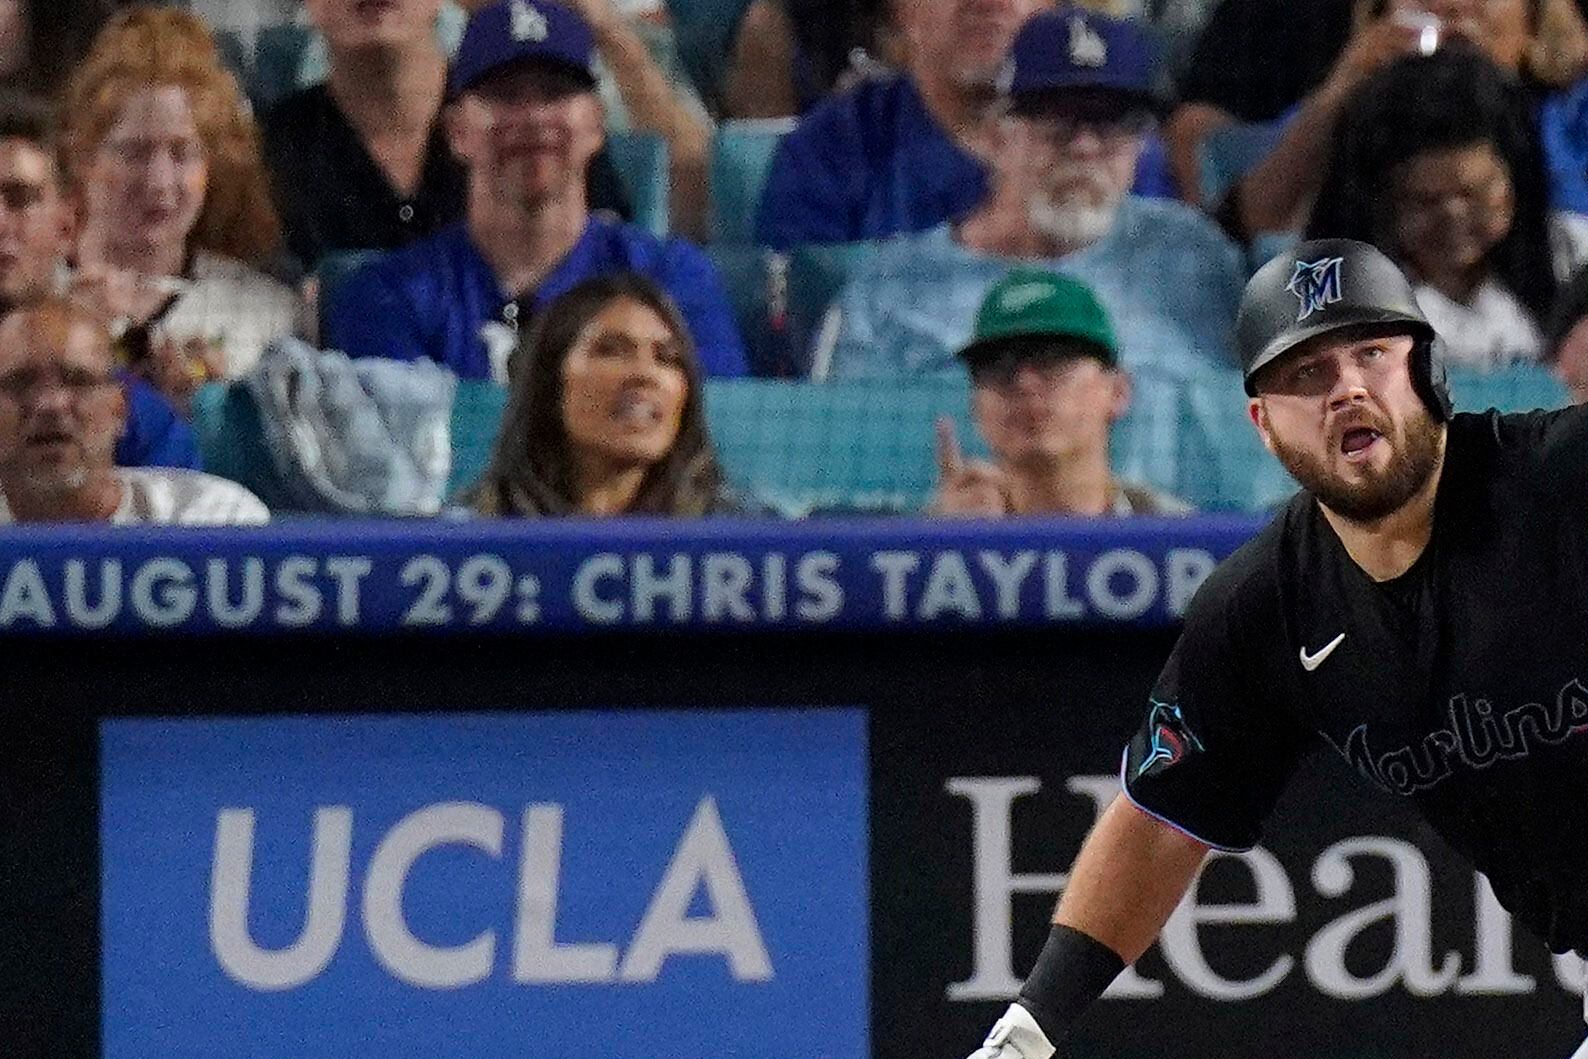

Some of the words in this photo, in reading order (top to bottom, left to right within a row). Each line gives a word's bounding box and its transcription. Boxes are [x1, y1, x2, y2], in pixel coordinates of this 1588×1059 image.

[0, 556, 373, 628] AUGUST
[400, 554, 541, 627] 29:
[572, 551, 846, 624] CHRIS
[210, 793, 775, 992] UCLA
